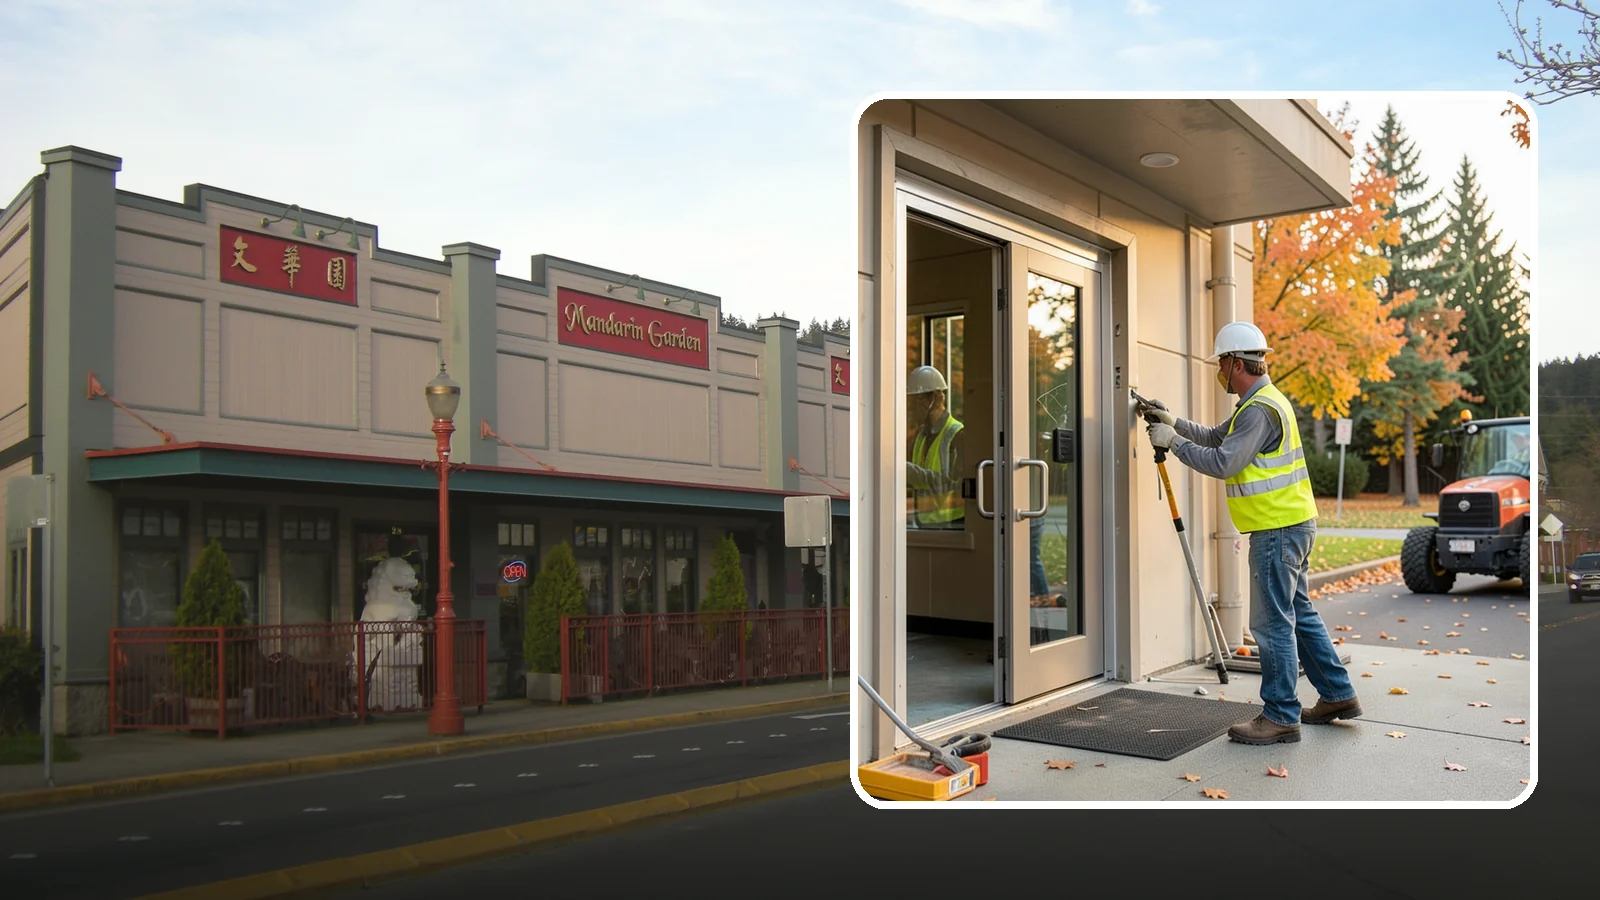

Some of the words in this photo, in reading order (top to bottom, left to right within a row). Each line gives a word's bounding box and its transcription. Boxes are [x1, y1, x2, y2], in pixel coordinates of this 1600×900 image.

[231, 236, 345, 290] 文華園
[564, 302, 644, 341] Mandarin
[648, 320, 702, 352] Garden
[503, 565, 527, 578] OPEN
